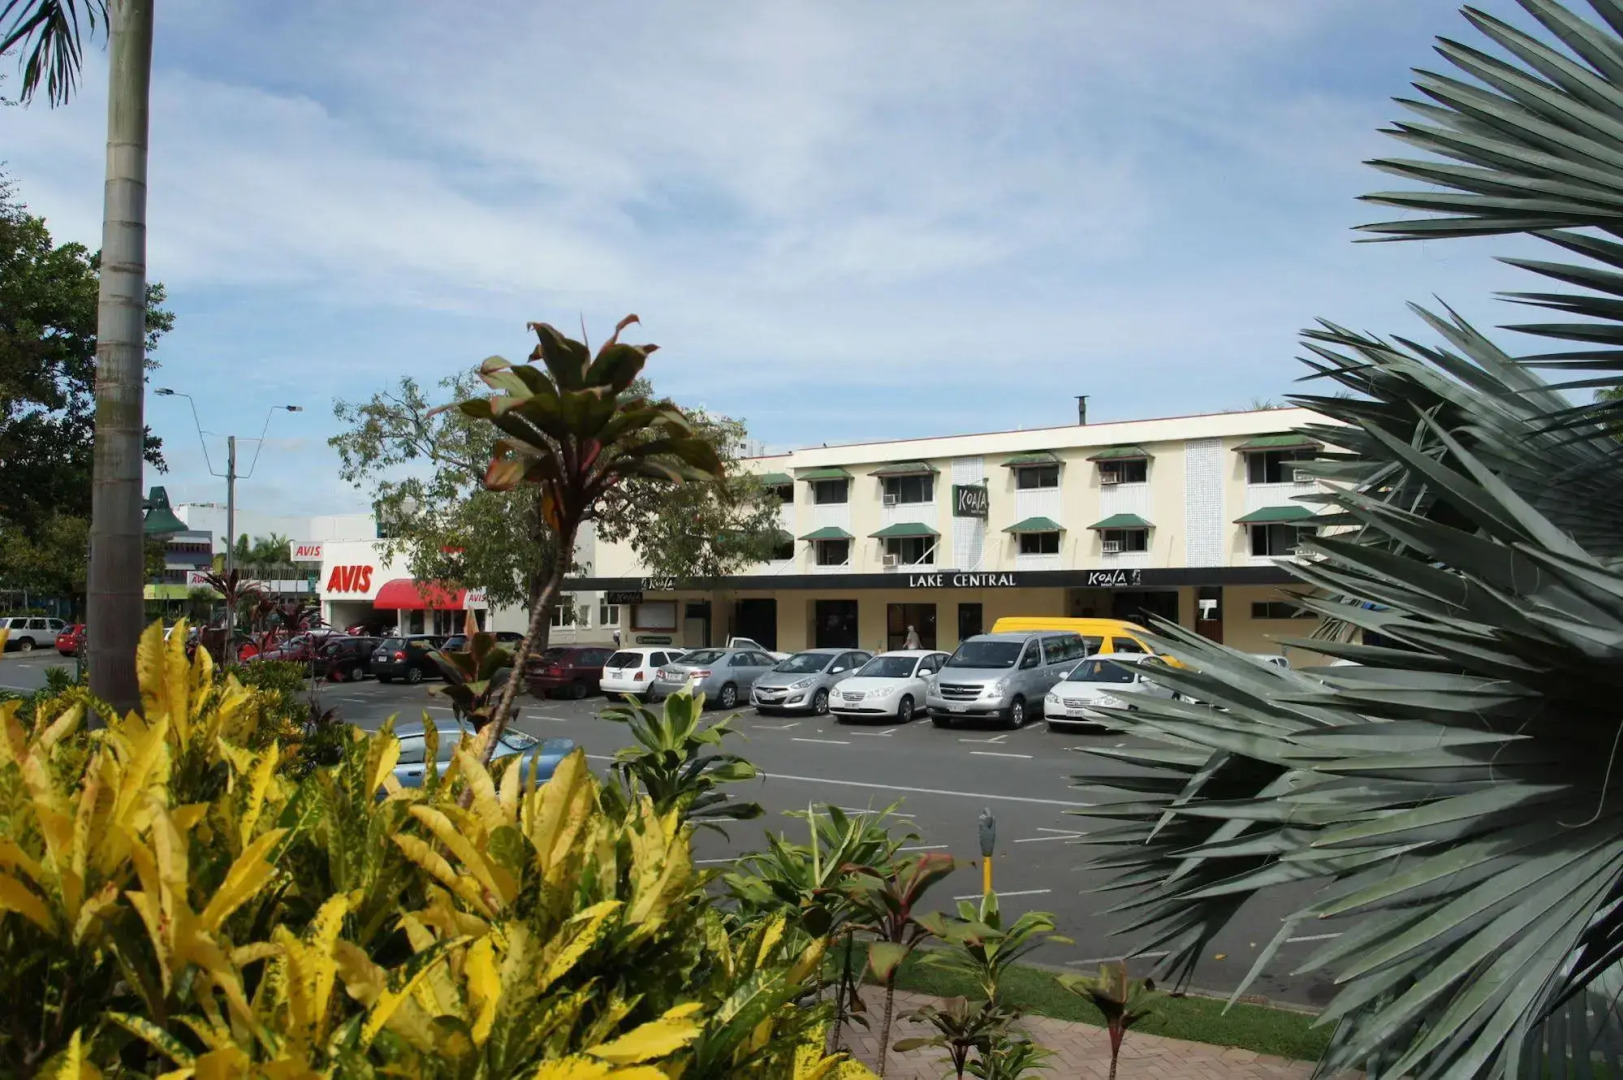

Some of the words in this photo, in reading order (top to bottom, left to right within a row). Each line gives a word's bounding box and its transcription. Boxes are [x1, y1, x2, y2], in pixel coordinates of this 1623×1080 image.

[295, 546, 321, 557] AVIS
[326, 565, 373, 593] AVIS
[909, 575, 943, 587] LAKE
[953, 573, 1016, 587] CENTRAL
[469, 594, 487, 602] AVIS
